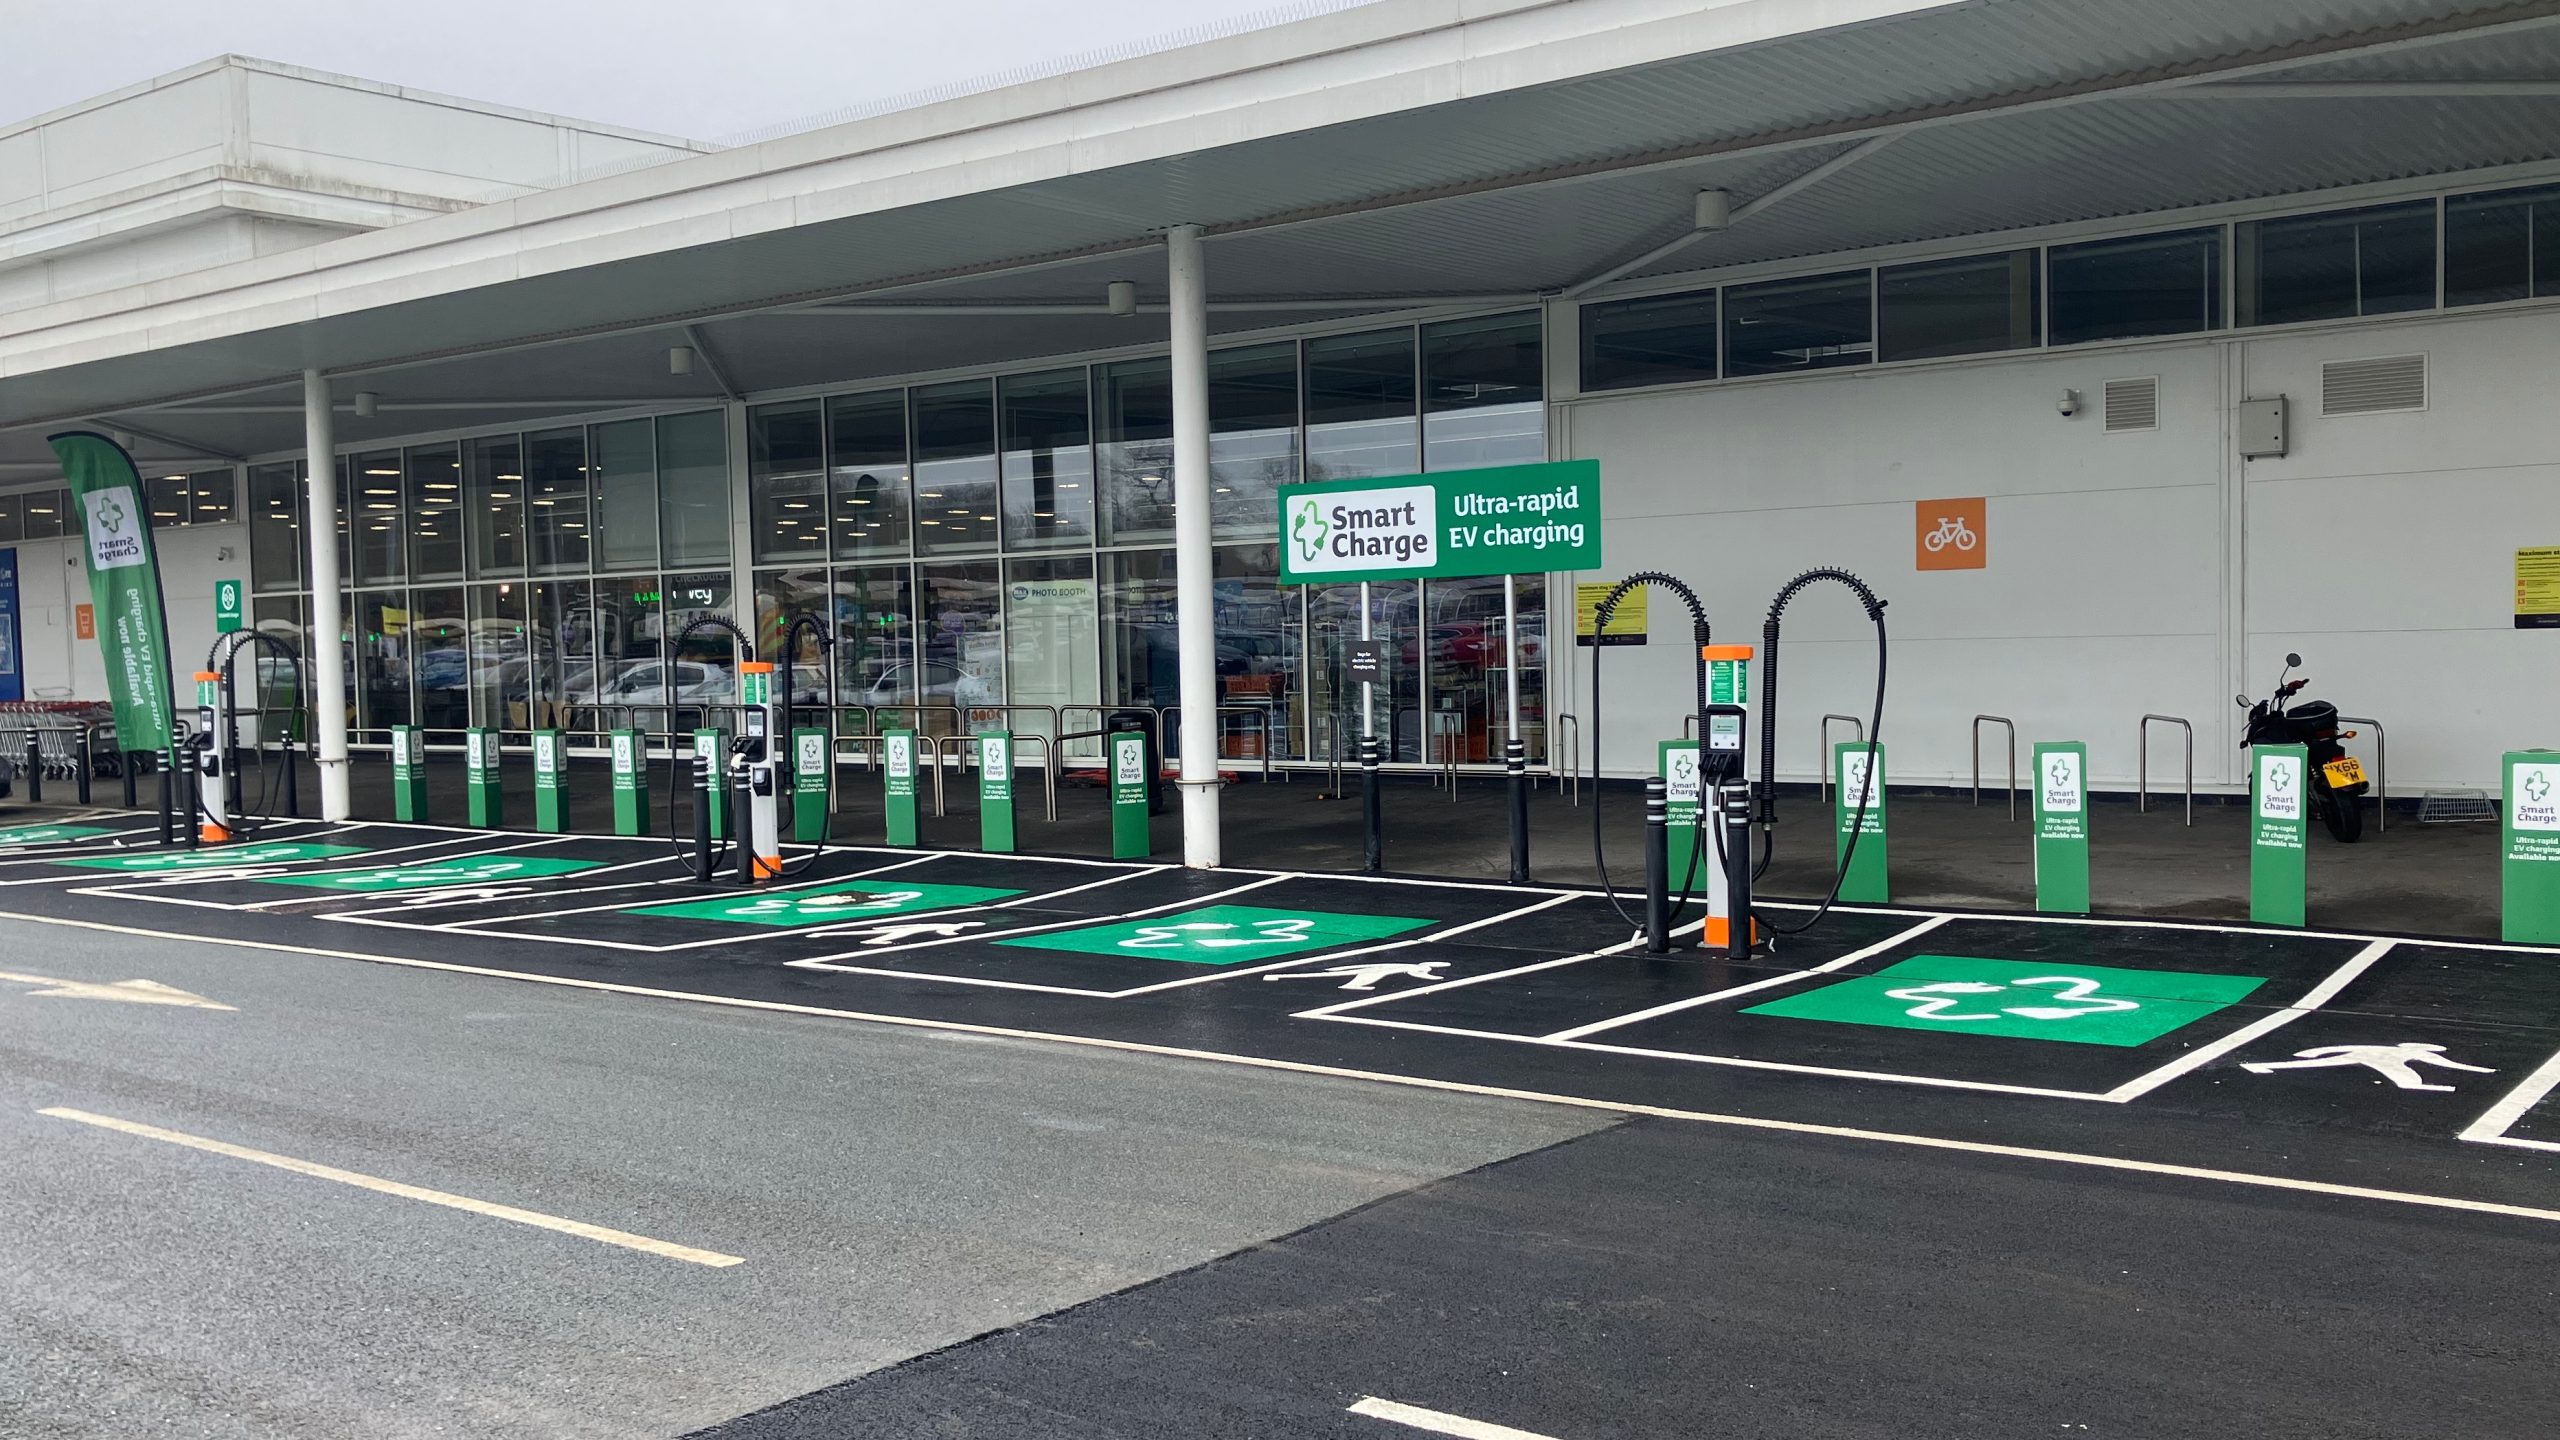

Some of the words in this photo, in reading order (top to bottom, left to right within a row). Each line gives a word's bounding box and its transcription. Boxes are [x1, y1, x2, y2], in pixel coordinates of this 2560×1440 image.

[1454, 485, 1579, 517] Ultra-rapid
[1332, 501, 1416, 530] Smart
[1449, 526, 1478, 548] EV
[1483, 520, 1584, 550] charging
[1332, 532, 1428, 561] Charge
[1032, 588, 1058, 597] PHOTO
[1059, 588, 1086, 597] BOOTH
[1847, 793, 1875, 802] Chage
[2048, 789, 2075, 797] Smart
[2046, 796, 2076, 805] Charge
[2266, 795, 2294, 803] Smart
[2264, 802, 2296, 812] Charge
[2521, 805, 2555, 814] Smart
[2046, 817, 2078, 825] Ultra-rapid
[2518, 813, 2558, 824] Charge
[2054, 824, 2080, 832] charging
[2262, 823, 2297, 833] Ultra-rapid
[2270, 831, 2298, 841] charging
[2515, 836, 2559, 845] Ultra-rapid
[2257, 839, 2287, 848] Available
[2526, 845, 2560, 855] charging
[2508, 853, 2547, 861] Available
